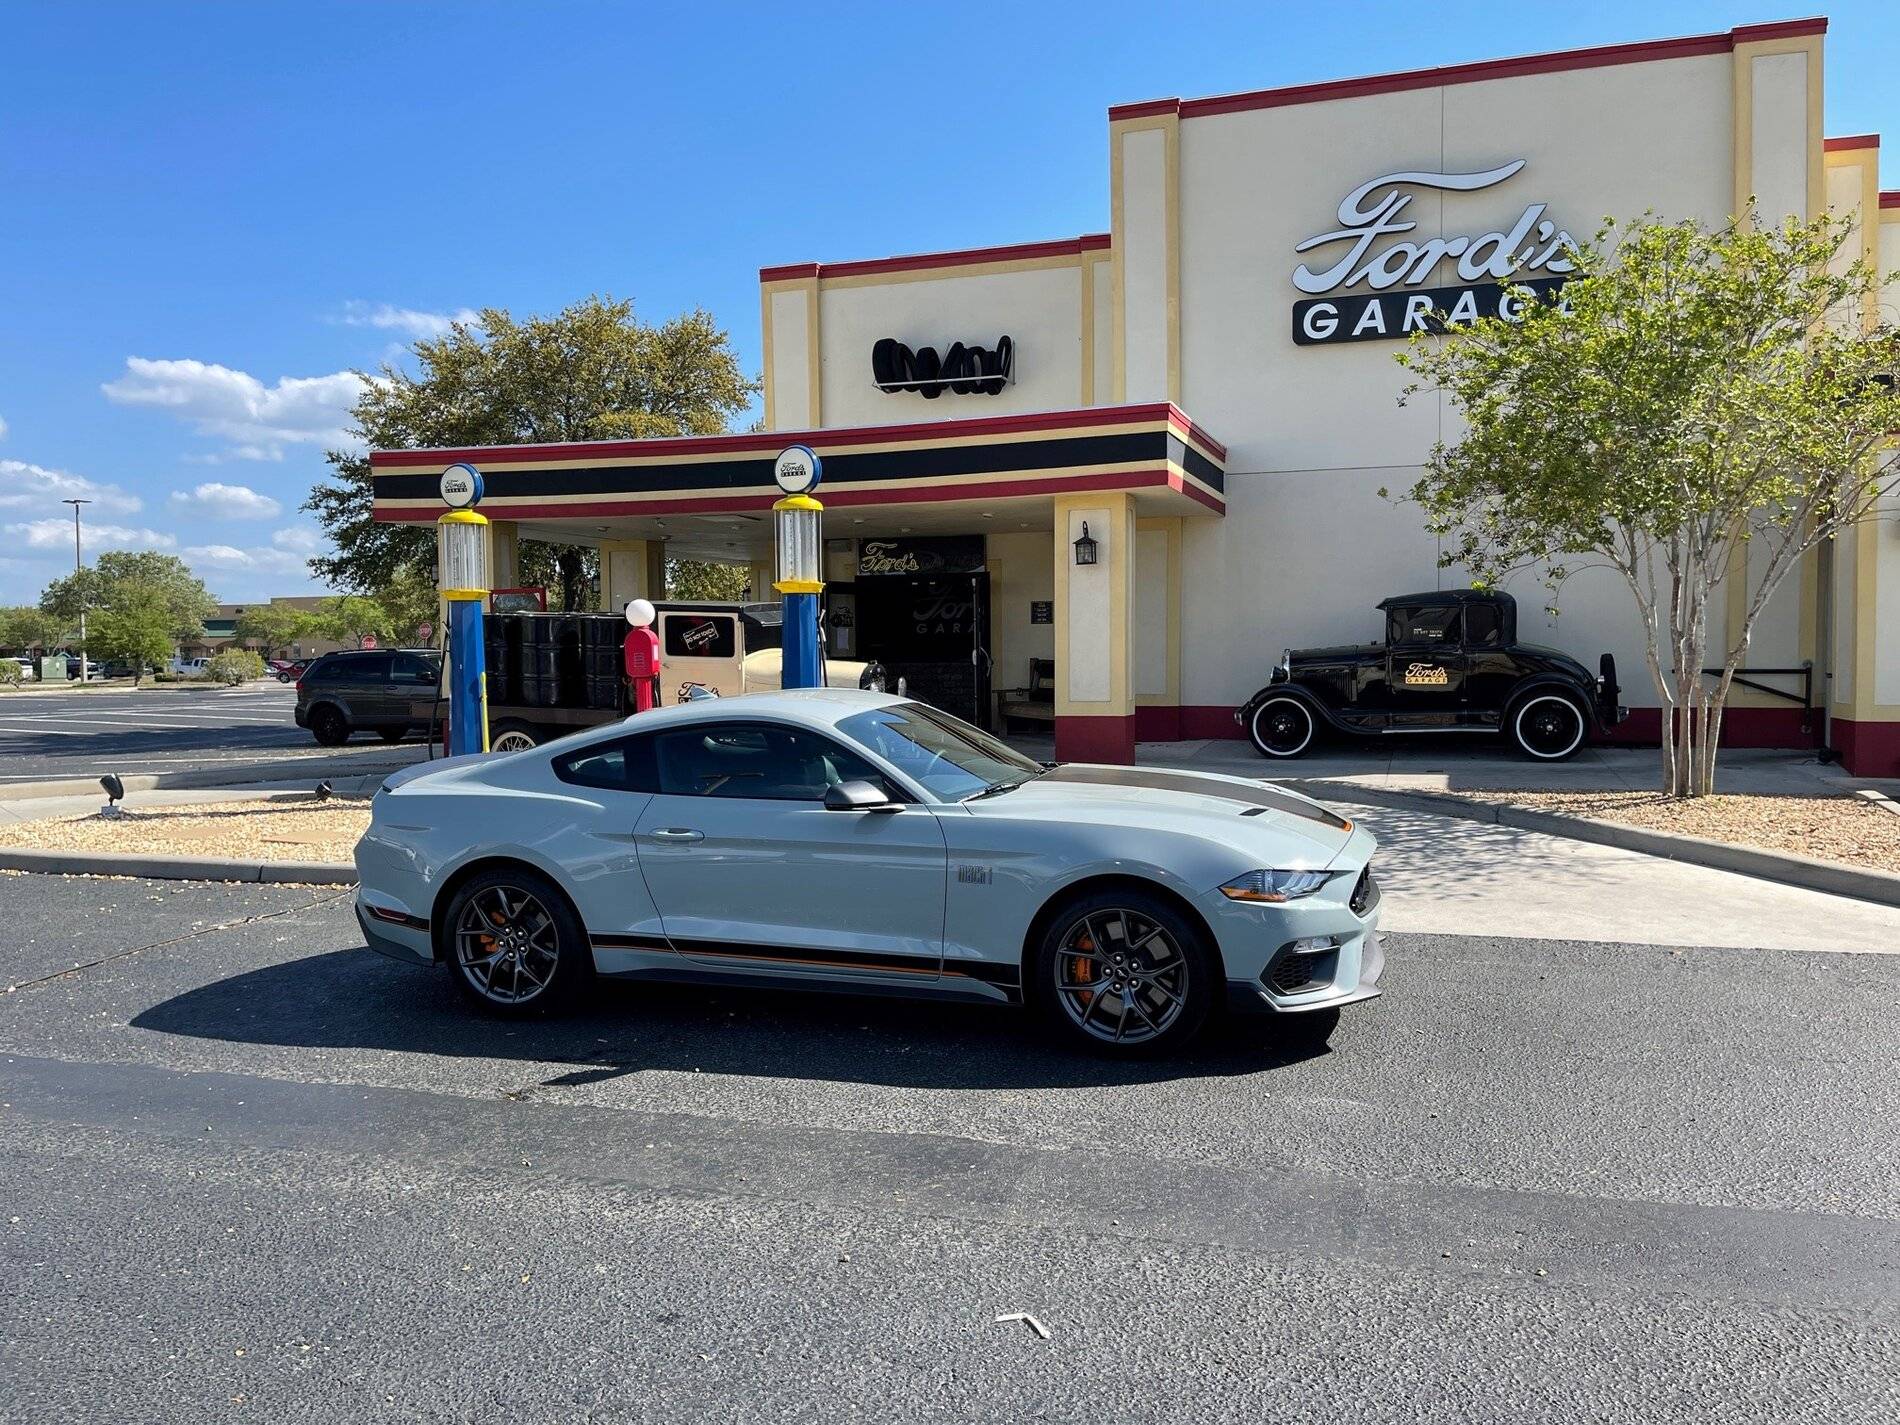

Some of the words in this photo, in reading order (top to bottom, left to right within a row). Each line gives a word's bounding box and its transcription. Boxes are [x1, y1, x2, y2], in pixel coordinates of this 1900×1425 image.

[1291, 158, 1582, 294] Ford's
[860, 542, 919, 571] Ford's
[1405, 662, 1447, 677] Ford's
